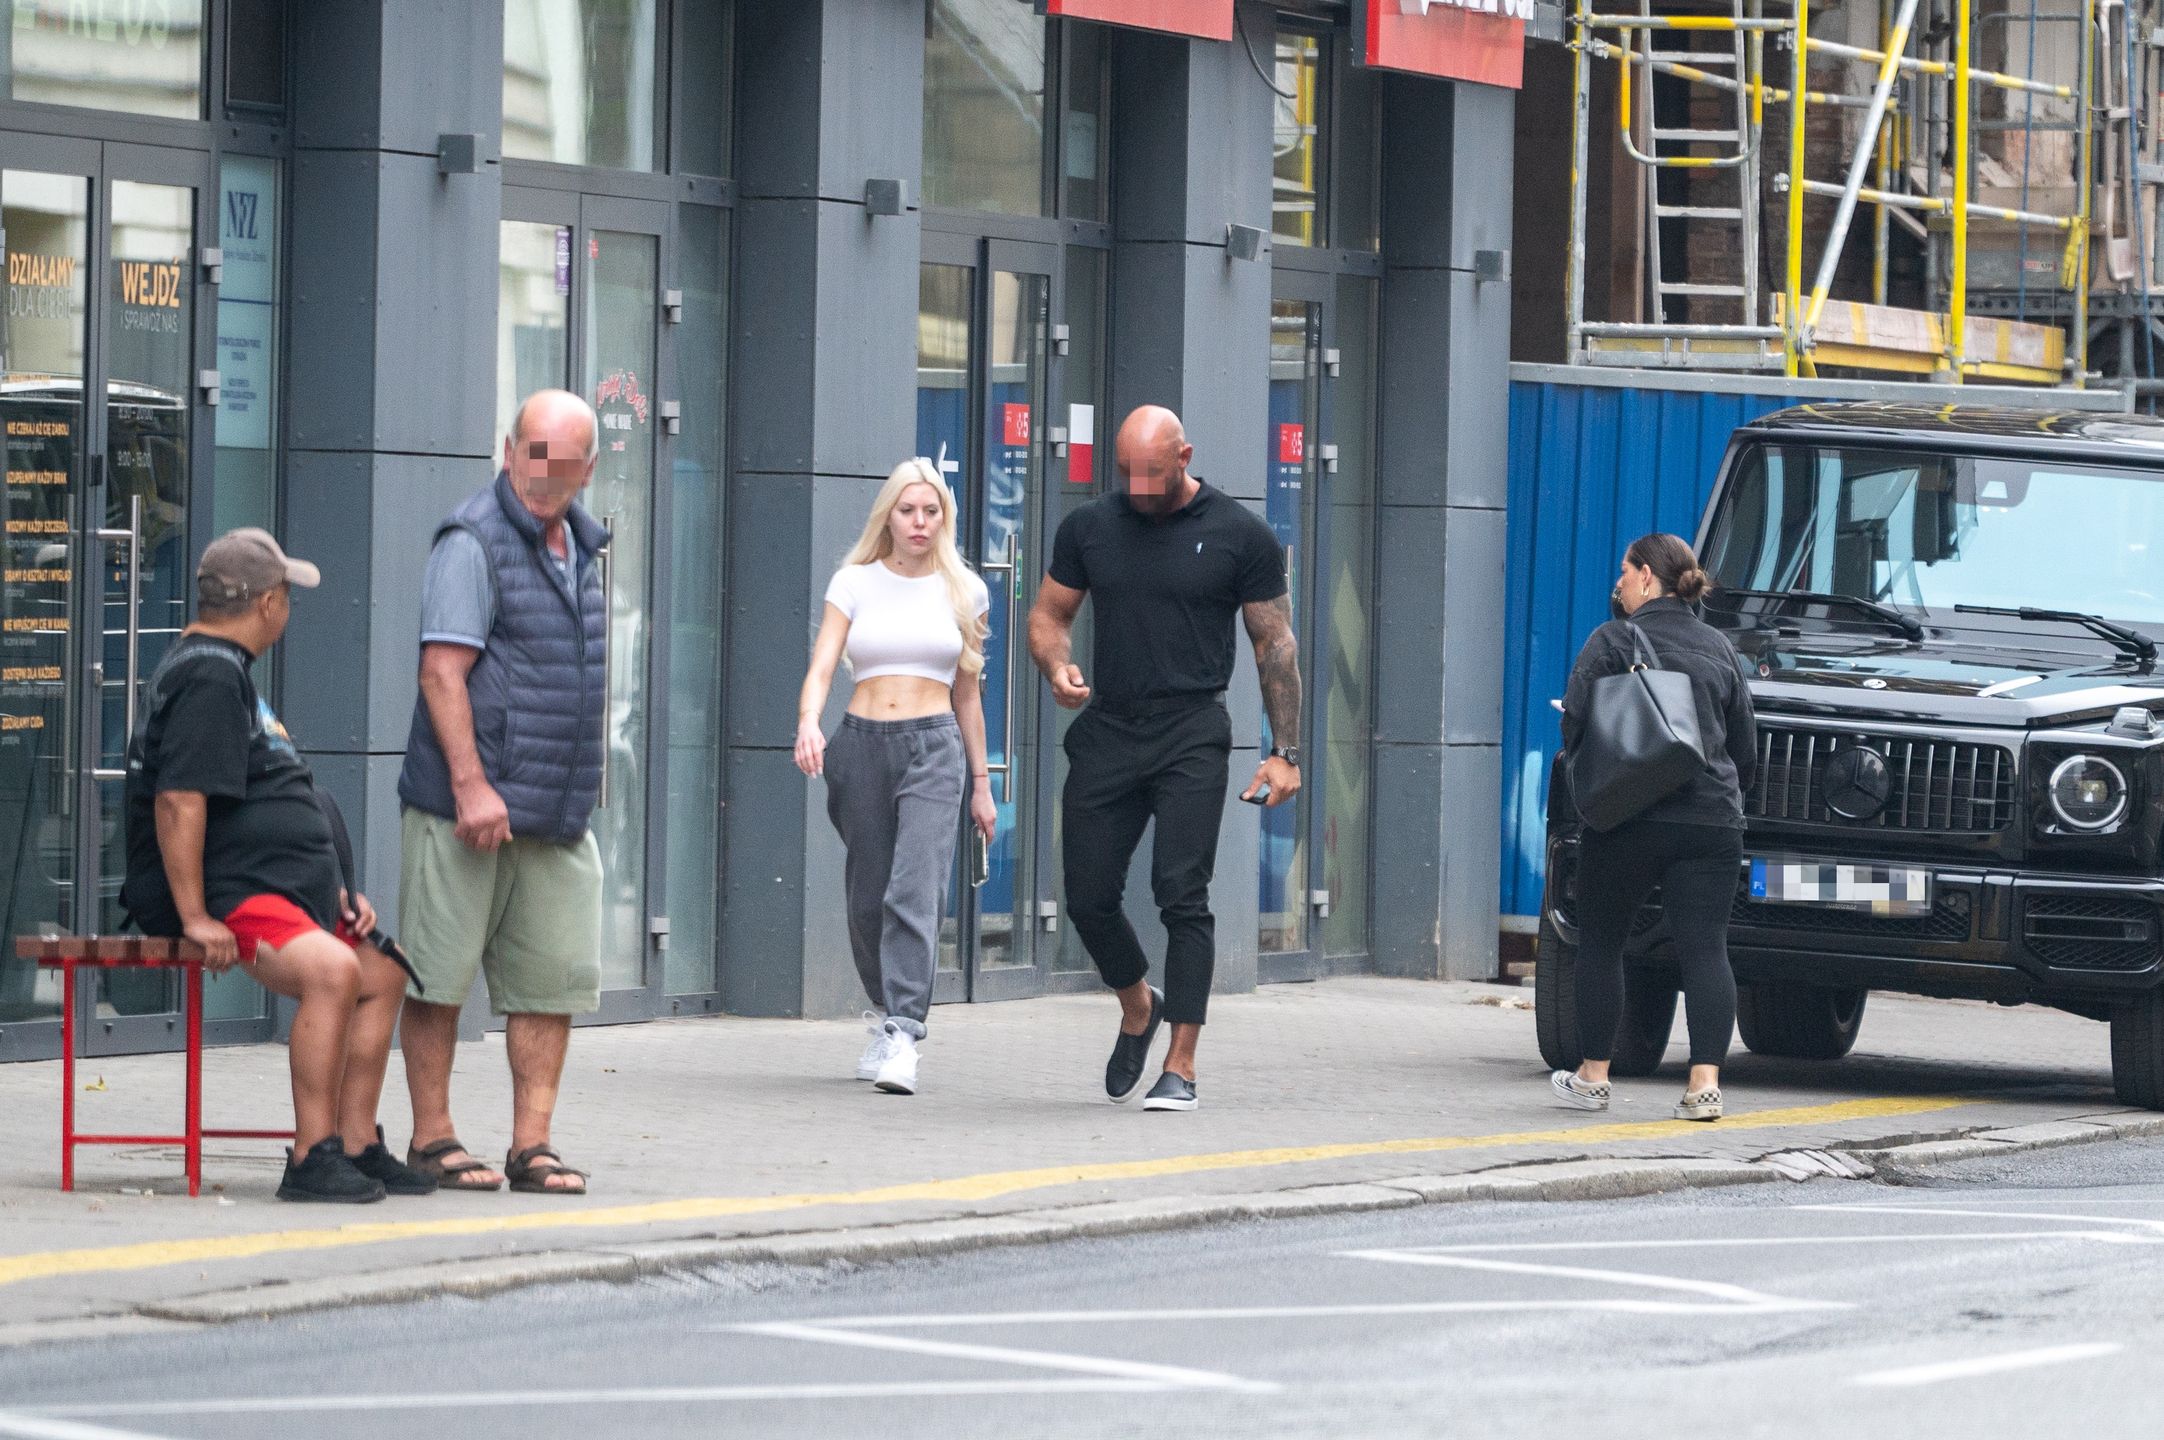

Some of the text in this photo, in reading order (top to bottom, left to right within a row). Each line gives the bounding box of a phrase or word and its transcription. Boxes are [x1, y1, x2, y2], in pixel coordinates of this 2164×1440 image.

[227, 191, 258, 239] NFZ
[9, 252, 76, 288] DZIAŁAMY
[121, 256, 181, 308] WEJDŹ
[9, 287, 34, 318] DLA
[1753, 881, 1765, 890] PL
